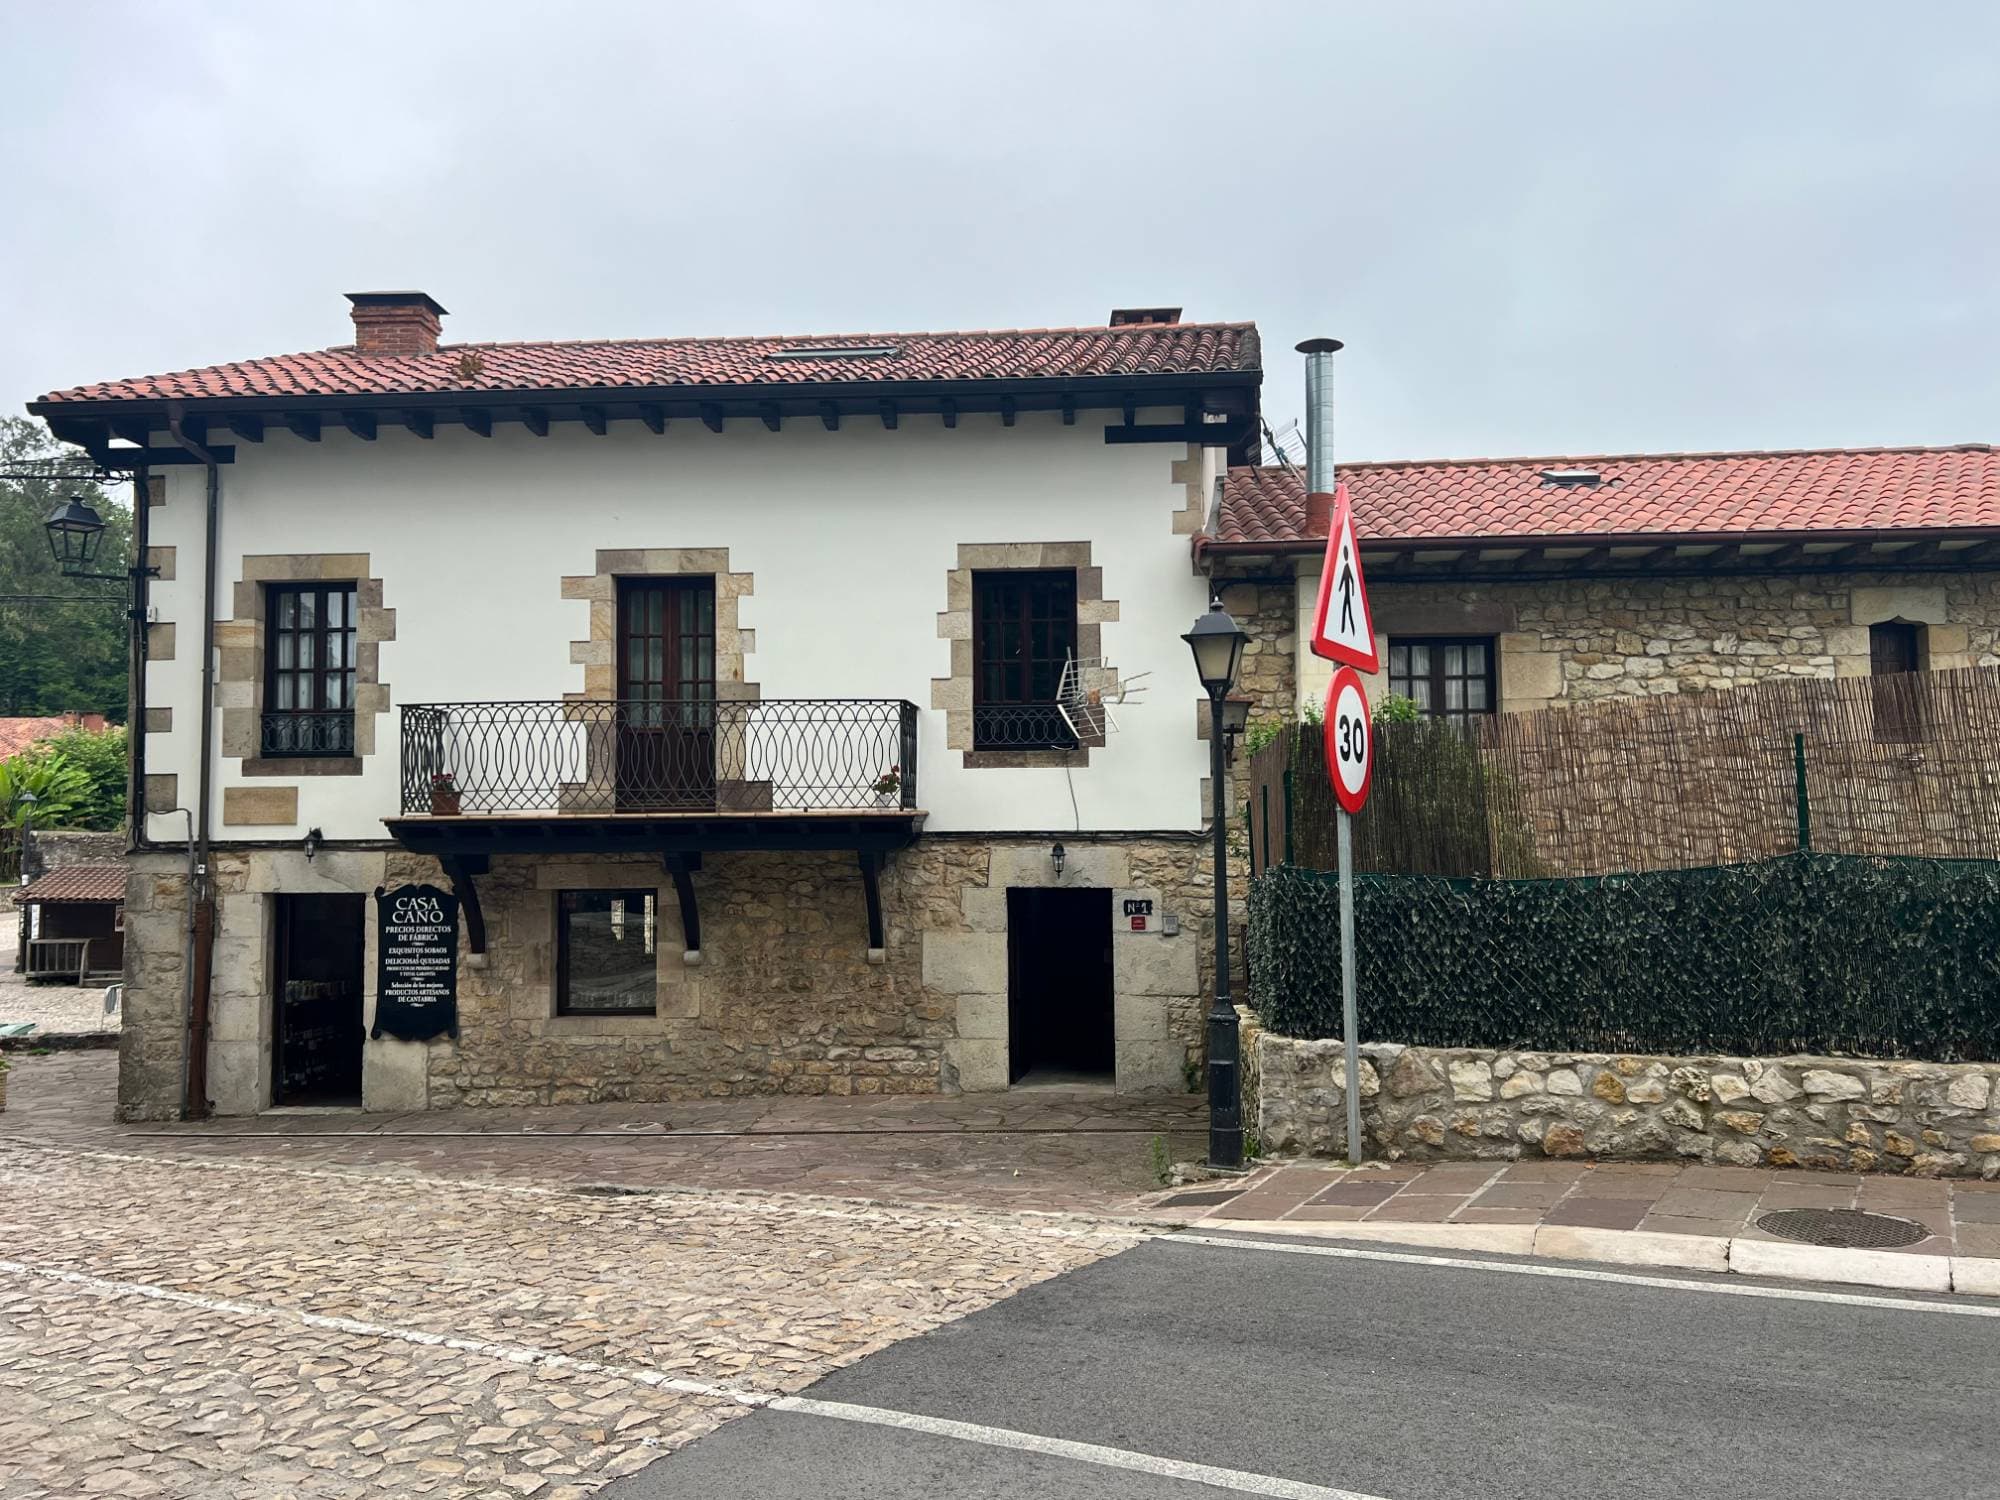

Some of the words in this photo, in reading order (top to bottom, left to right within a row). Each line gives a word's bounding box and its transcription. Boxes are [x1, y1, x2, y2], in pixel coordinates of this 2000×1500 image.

[1340, 714, 1364, 764] 30
[396, 897, 440, 910] CASA
[392, 910, 444, 924] CANO
[409, 933, 438, 941] FÁBRICA
